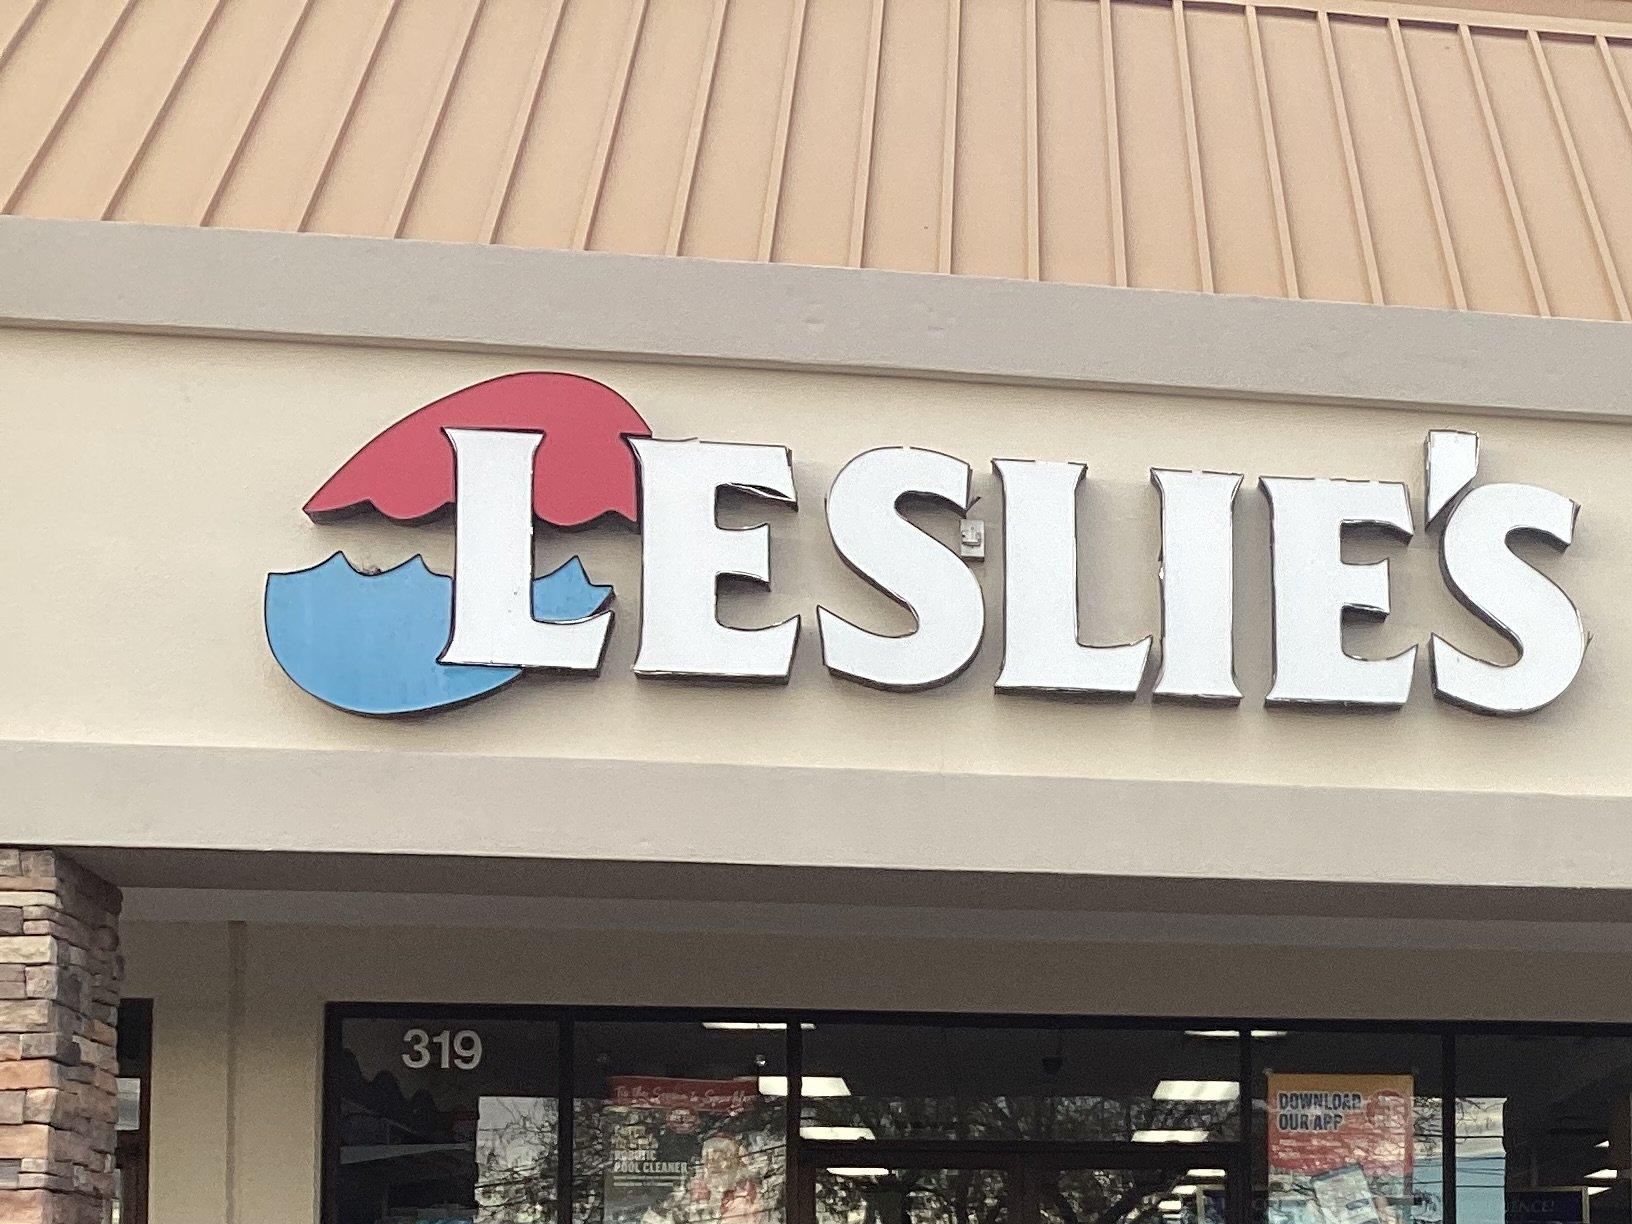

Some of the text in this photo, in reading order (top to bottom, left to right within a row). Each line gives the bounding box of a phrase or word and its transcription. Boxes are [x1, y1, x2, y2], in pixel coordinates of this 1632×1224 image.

[437, 426, 1588, 717] LESLIE'S
[401, 1028, 482, 1070] 319
[1278, 1092, 1362, 1111] DOWNLOAD
[1278, 1113, 1343, 1131] OUR APP
[614, 1161, 688, 1173] POOL CLEANER
